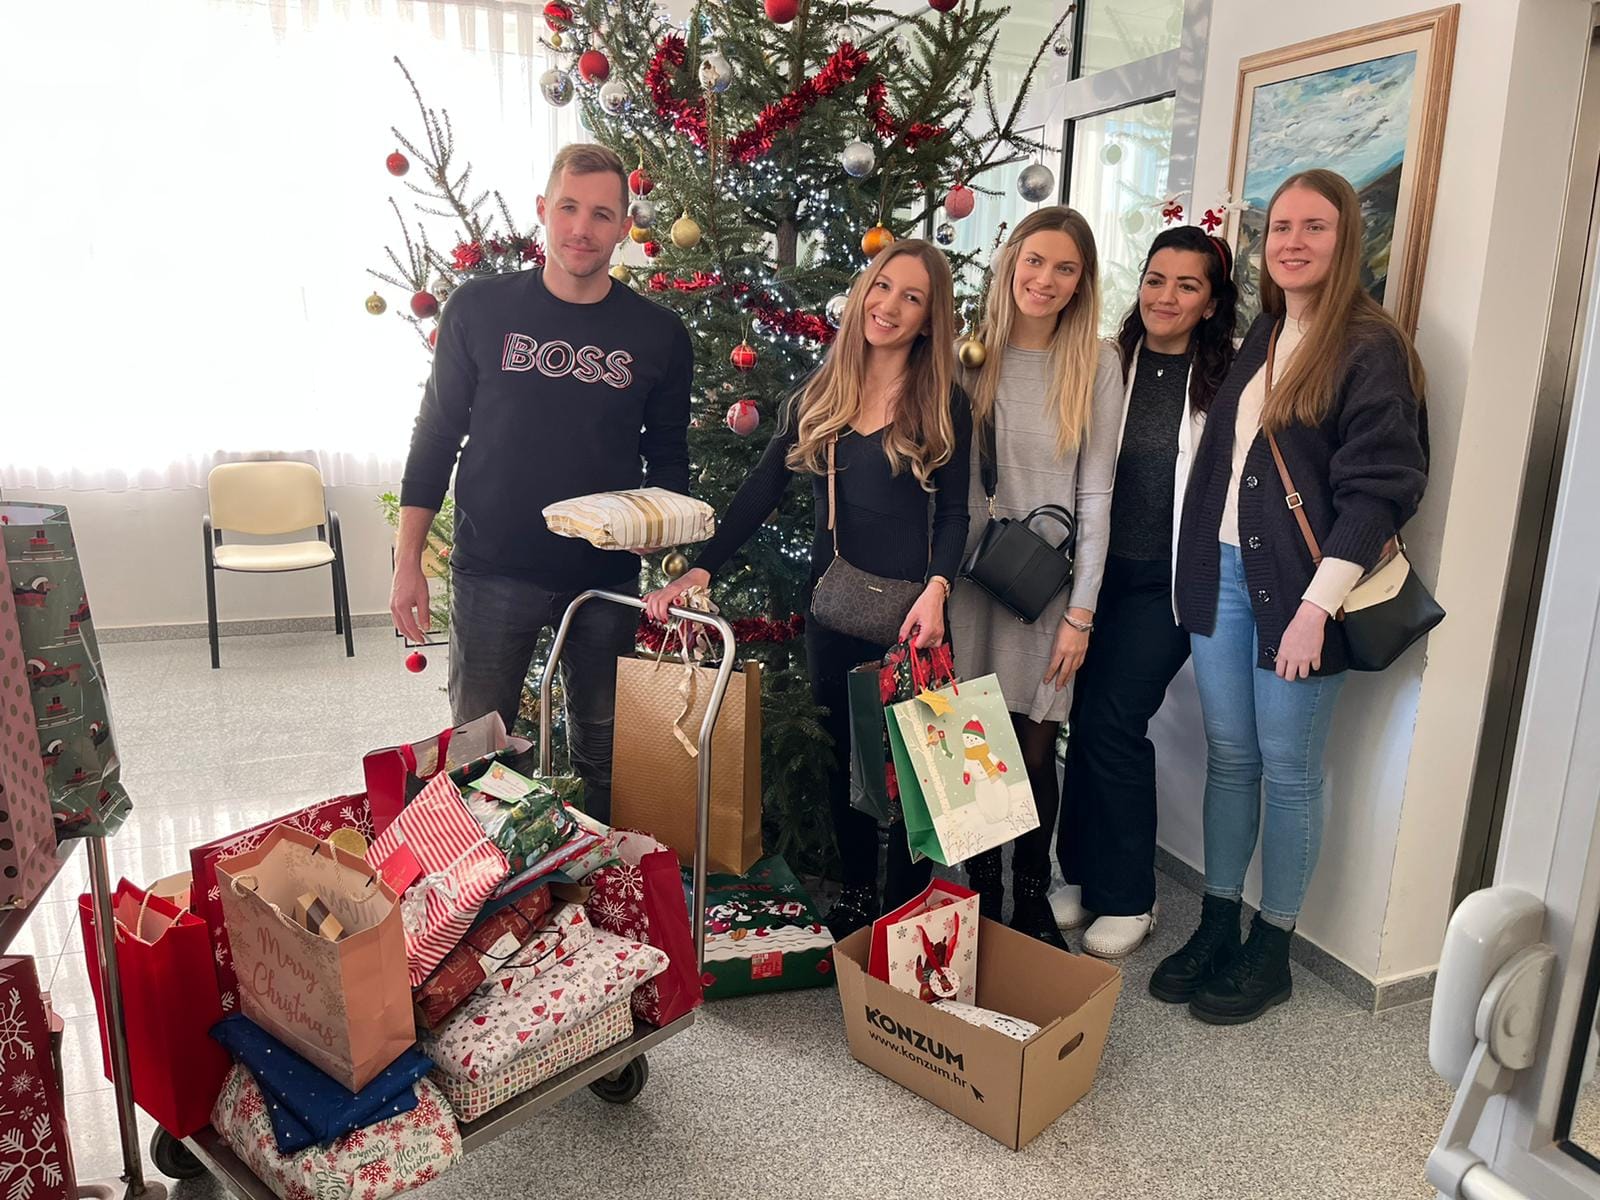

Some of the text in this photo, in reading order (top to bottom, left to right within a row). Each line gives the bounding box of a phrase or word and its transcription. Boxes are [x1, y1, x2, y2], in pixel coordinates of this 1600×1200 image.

[502, 332, 634, 389] BOSS
[257, 927, 318, 994] Merry
[253, 961, 338, 1046] Christmas
[865, 1005, 964, 1071] KONZUM
[868, 1030, 967, 1088] www.konzum.hr
[396, 1141, 430, 1169] Merry
[397, 1153, 441, 1178] Christmas
